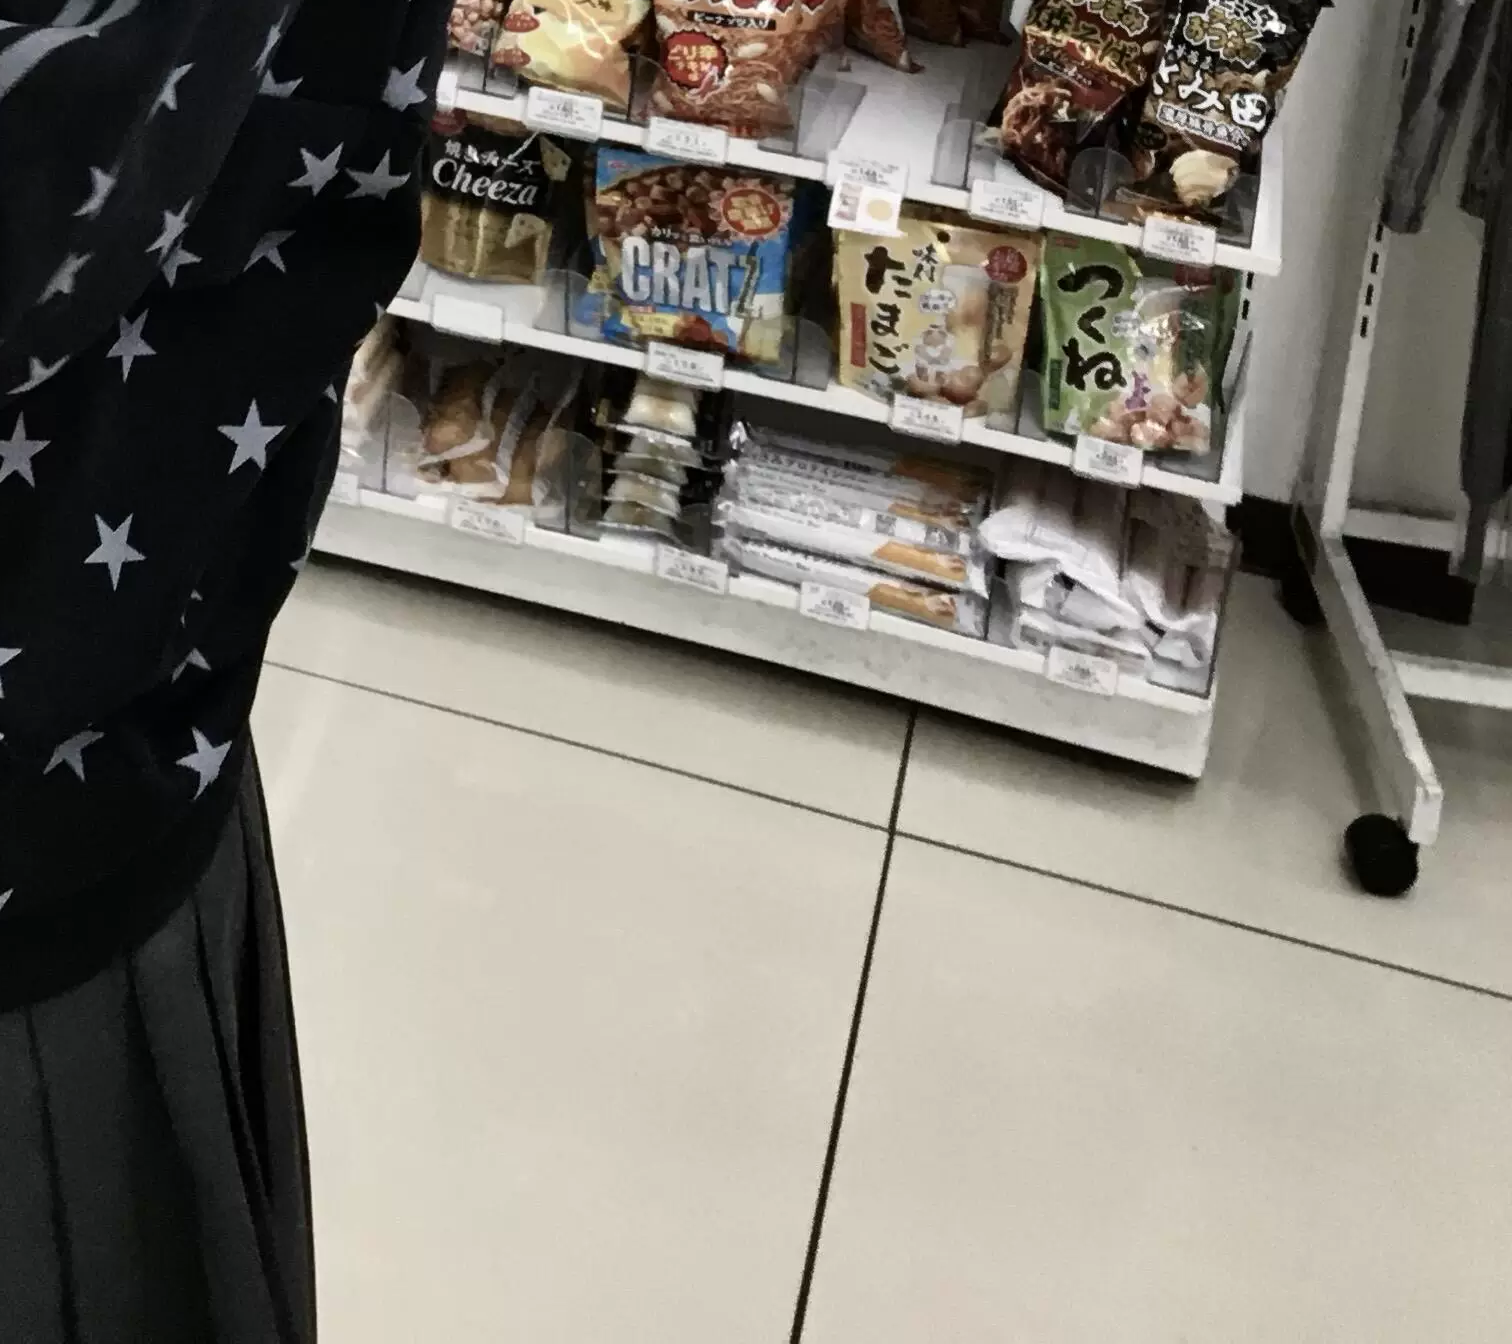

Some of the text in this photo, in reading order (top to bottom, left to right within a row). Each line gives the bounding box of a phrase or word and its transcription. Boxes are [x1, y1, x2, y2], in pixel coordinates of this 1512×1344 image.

[431, 157, 538, 206] Cheeza
[864, 245, 914, 375] たまご
[1056, 263, 1127, 391] つくね
